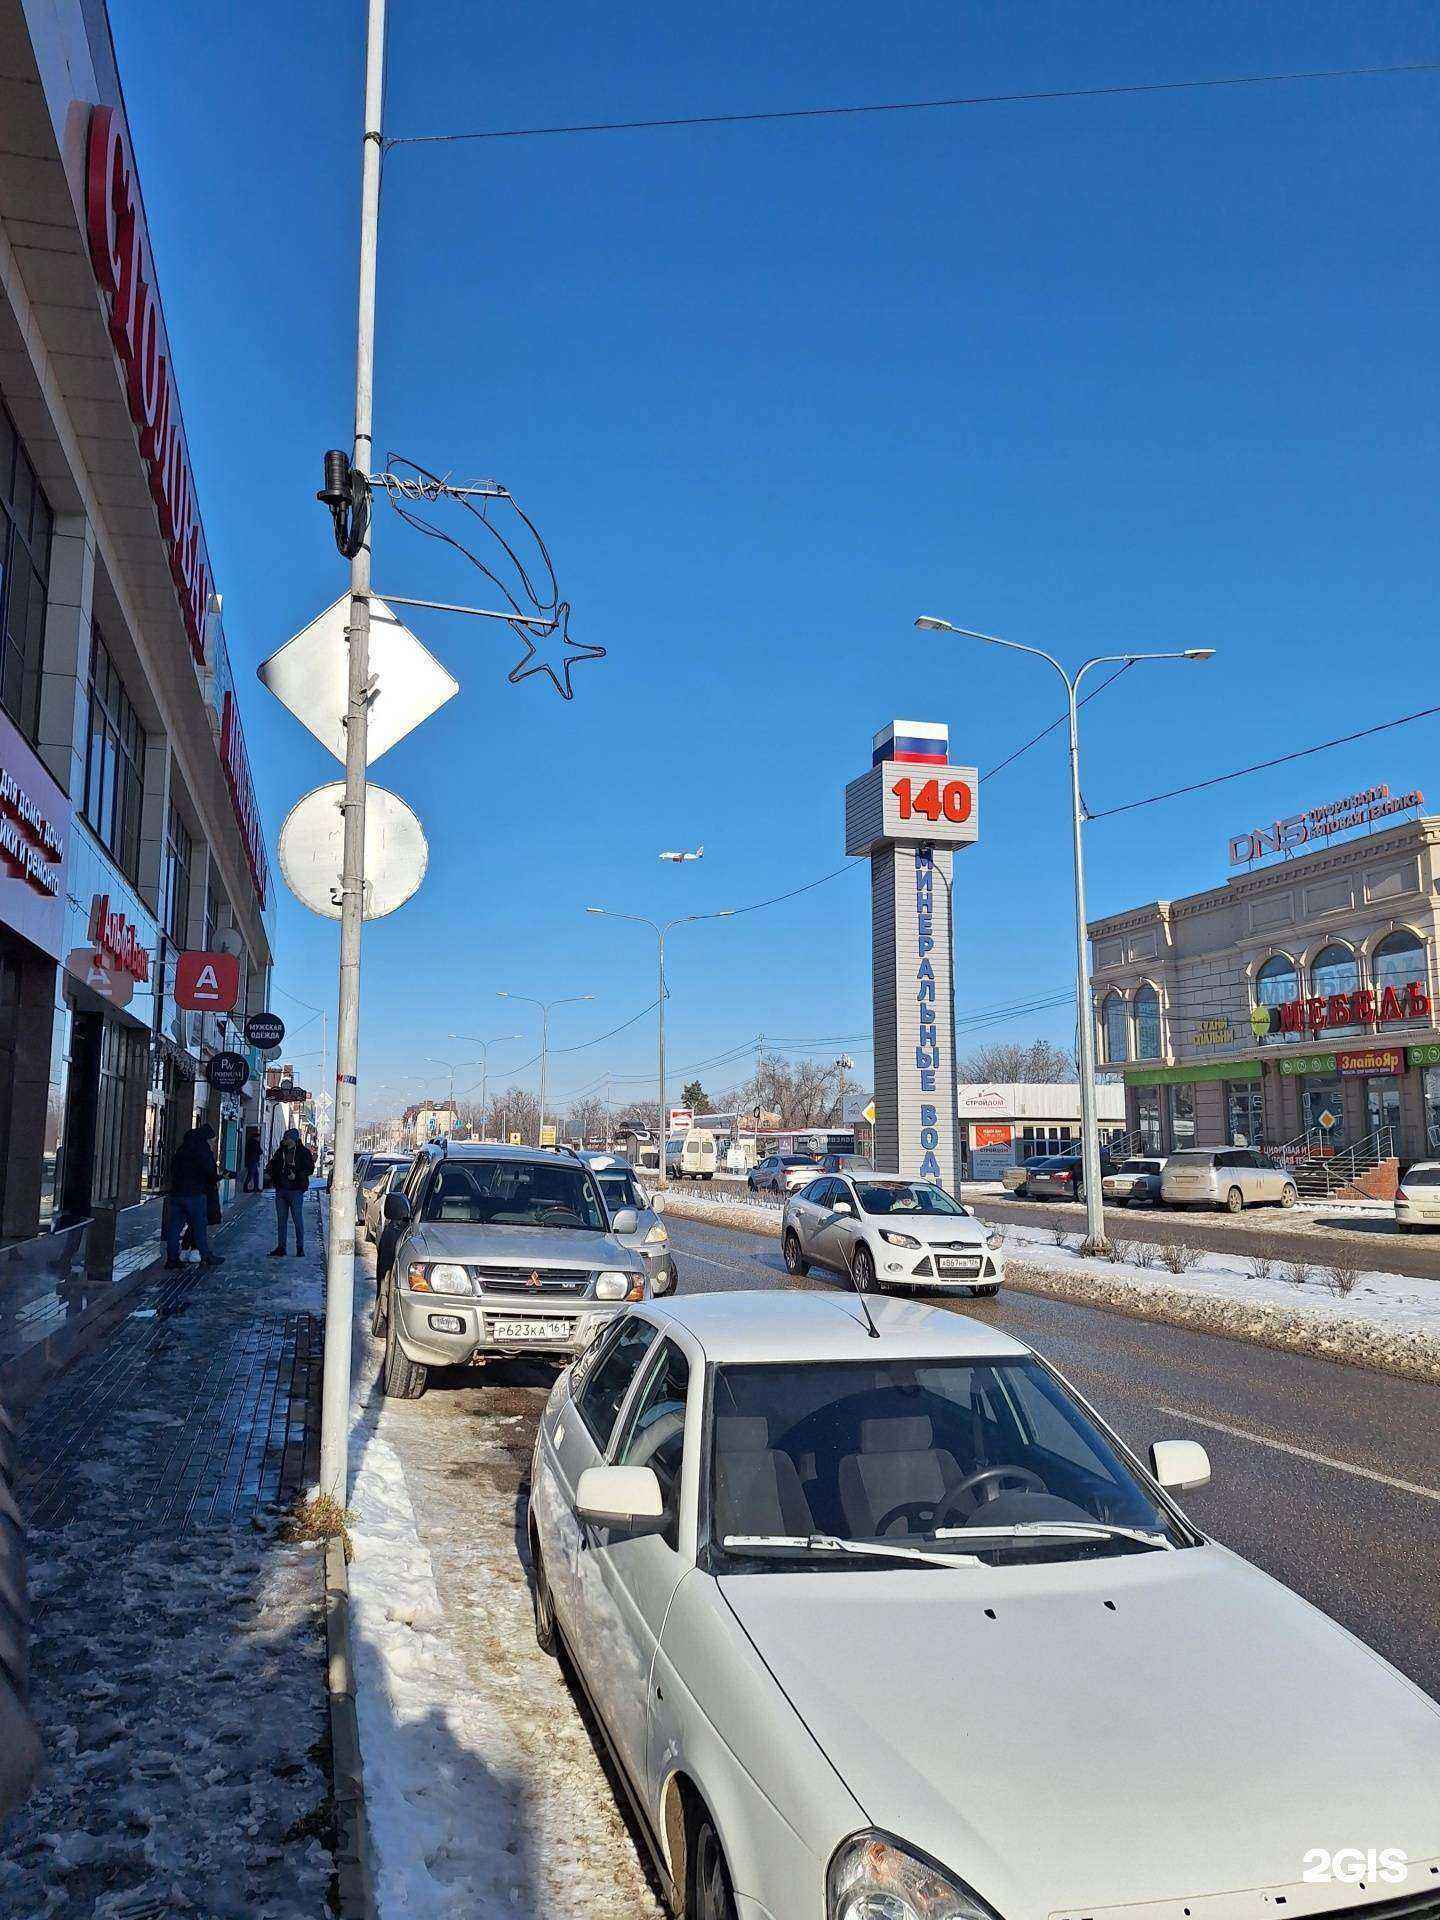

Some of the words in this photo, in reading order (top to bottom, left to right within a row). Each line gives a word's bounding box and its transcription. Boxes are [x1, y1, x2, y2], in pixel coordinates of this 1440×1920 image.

[892, 778, 971, 823] 140
[1229, 814, 1309, 866] DNS
[915, 848, 940, 1092] МИНЕРАЛЬНЫЕ
[250, 1023, 281, 1031] МУЖСКАЯ
[1279, 980, 1432, 1033] МЕБЕЛЬ
[251, 1031, 280, 1039] ОДЕЖДА
[1342, 1052, 1399, 1072] ЗлатоЯр
[920, 1104, 943, 1187] ВОД
[498, 1324, 546, 1336] Р623КА
[548, 1323, 567, 1333] 161
